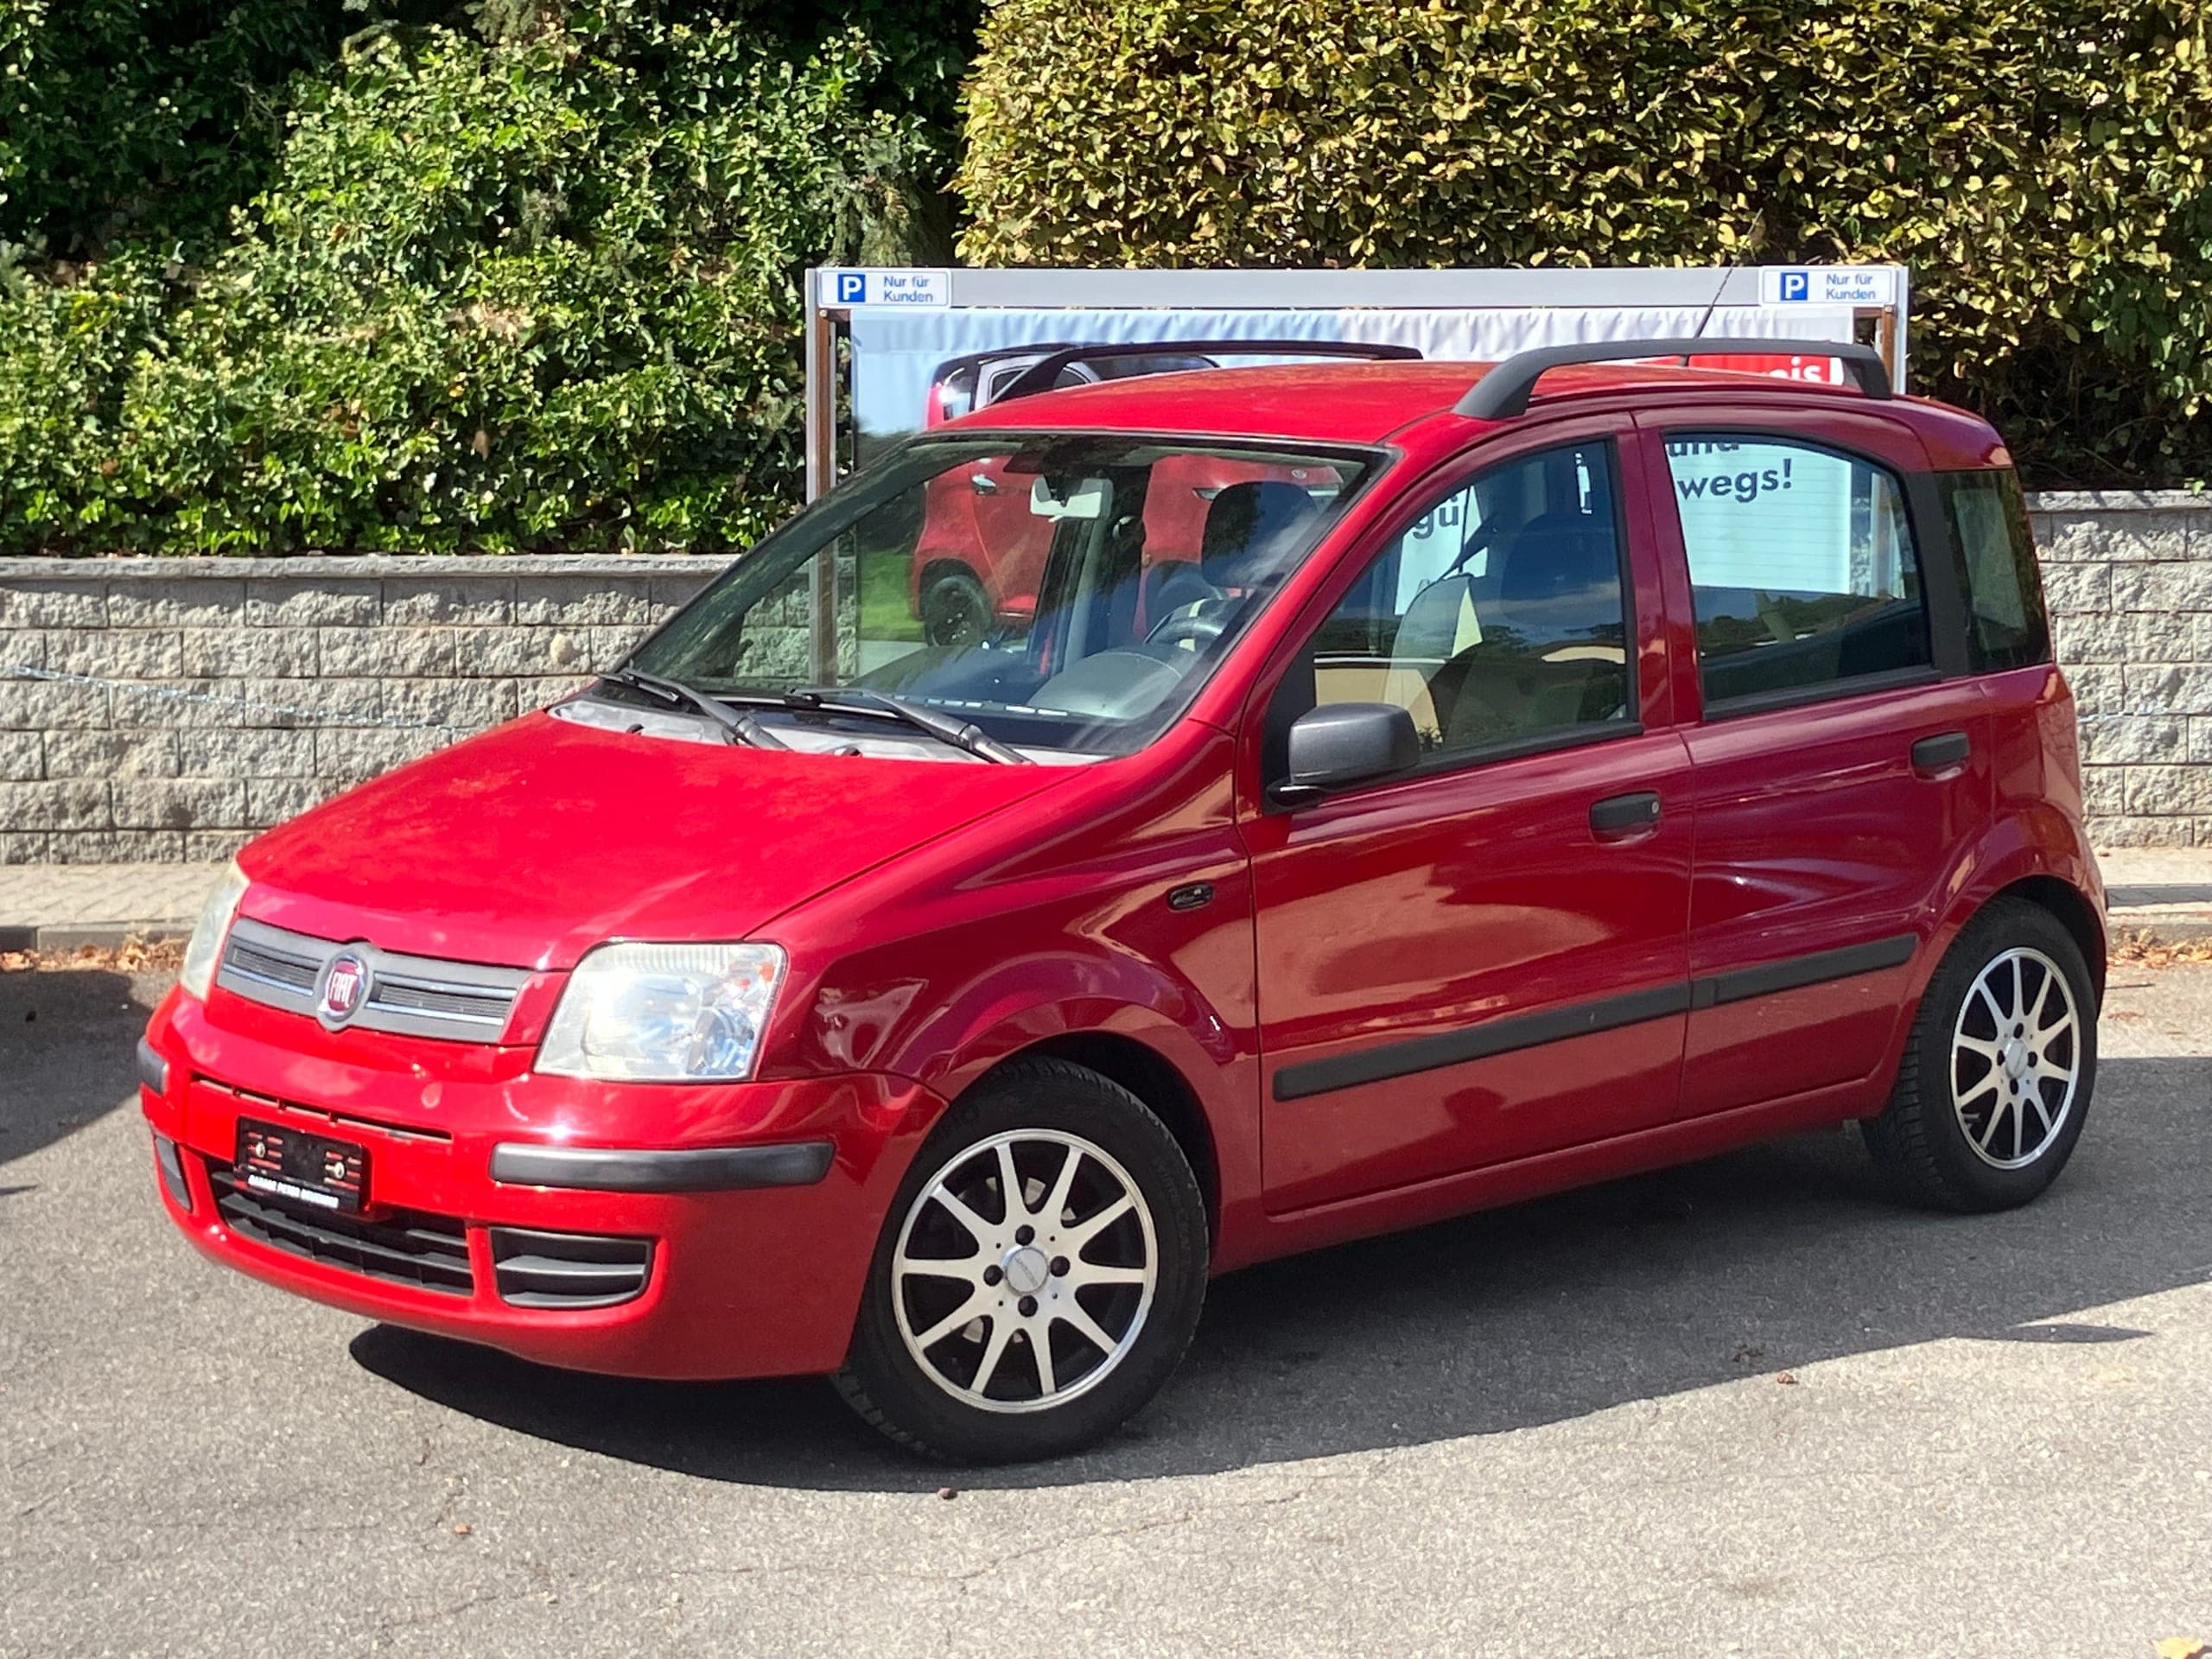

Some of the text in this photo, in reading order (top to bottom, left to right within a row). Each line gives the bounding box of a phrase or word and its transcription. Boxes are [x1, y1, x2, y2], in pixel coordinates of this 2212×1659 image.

[883, 276, 930, 288] Nur für
[1785, 275, 1805, 299] P
[1826, 273, 1873, 285] Nur für
[842, 276, 862, 301] P
[883, 290, 934, 302] Kunden
[1826, 289, 1877, 301] Kunden
[1676, 458, 1792, 503] wegs!
[329, 970, 359, 1003] FIAT
